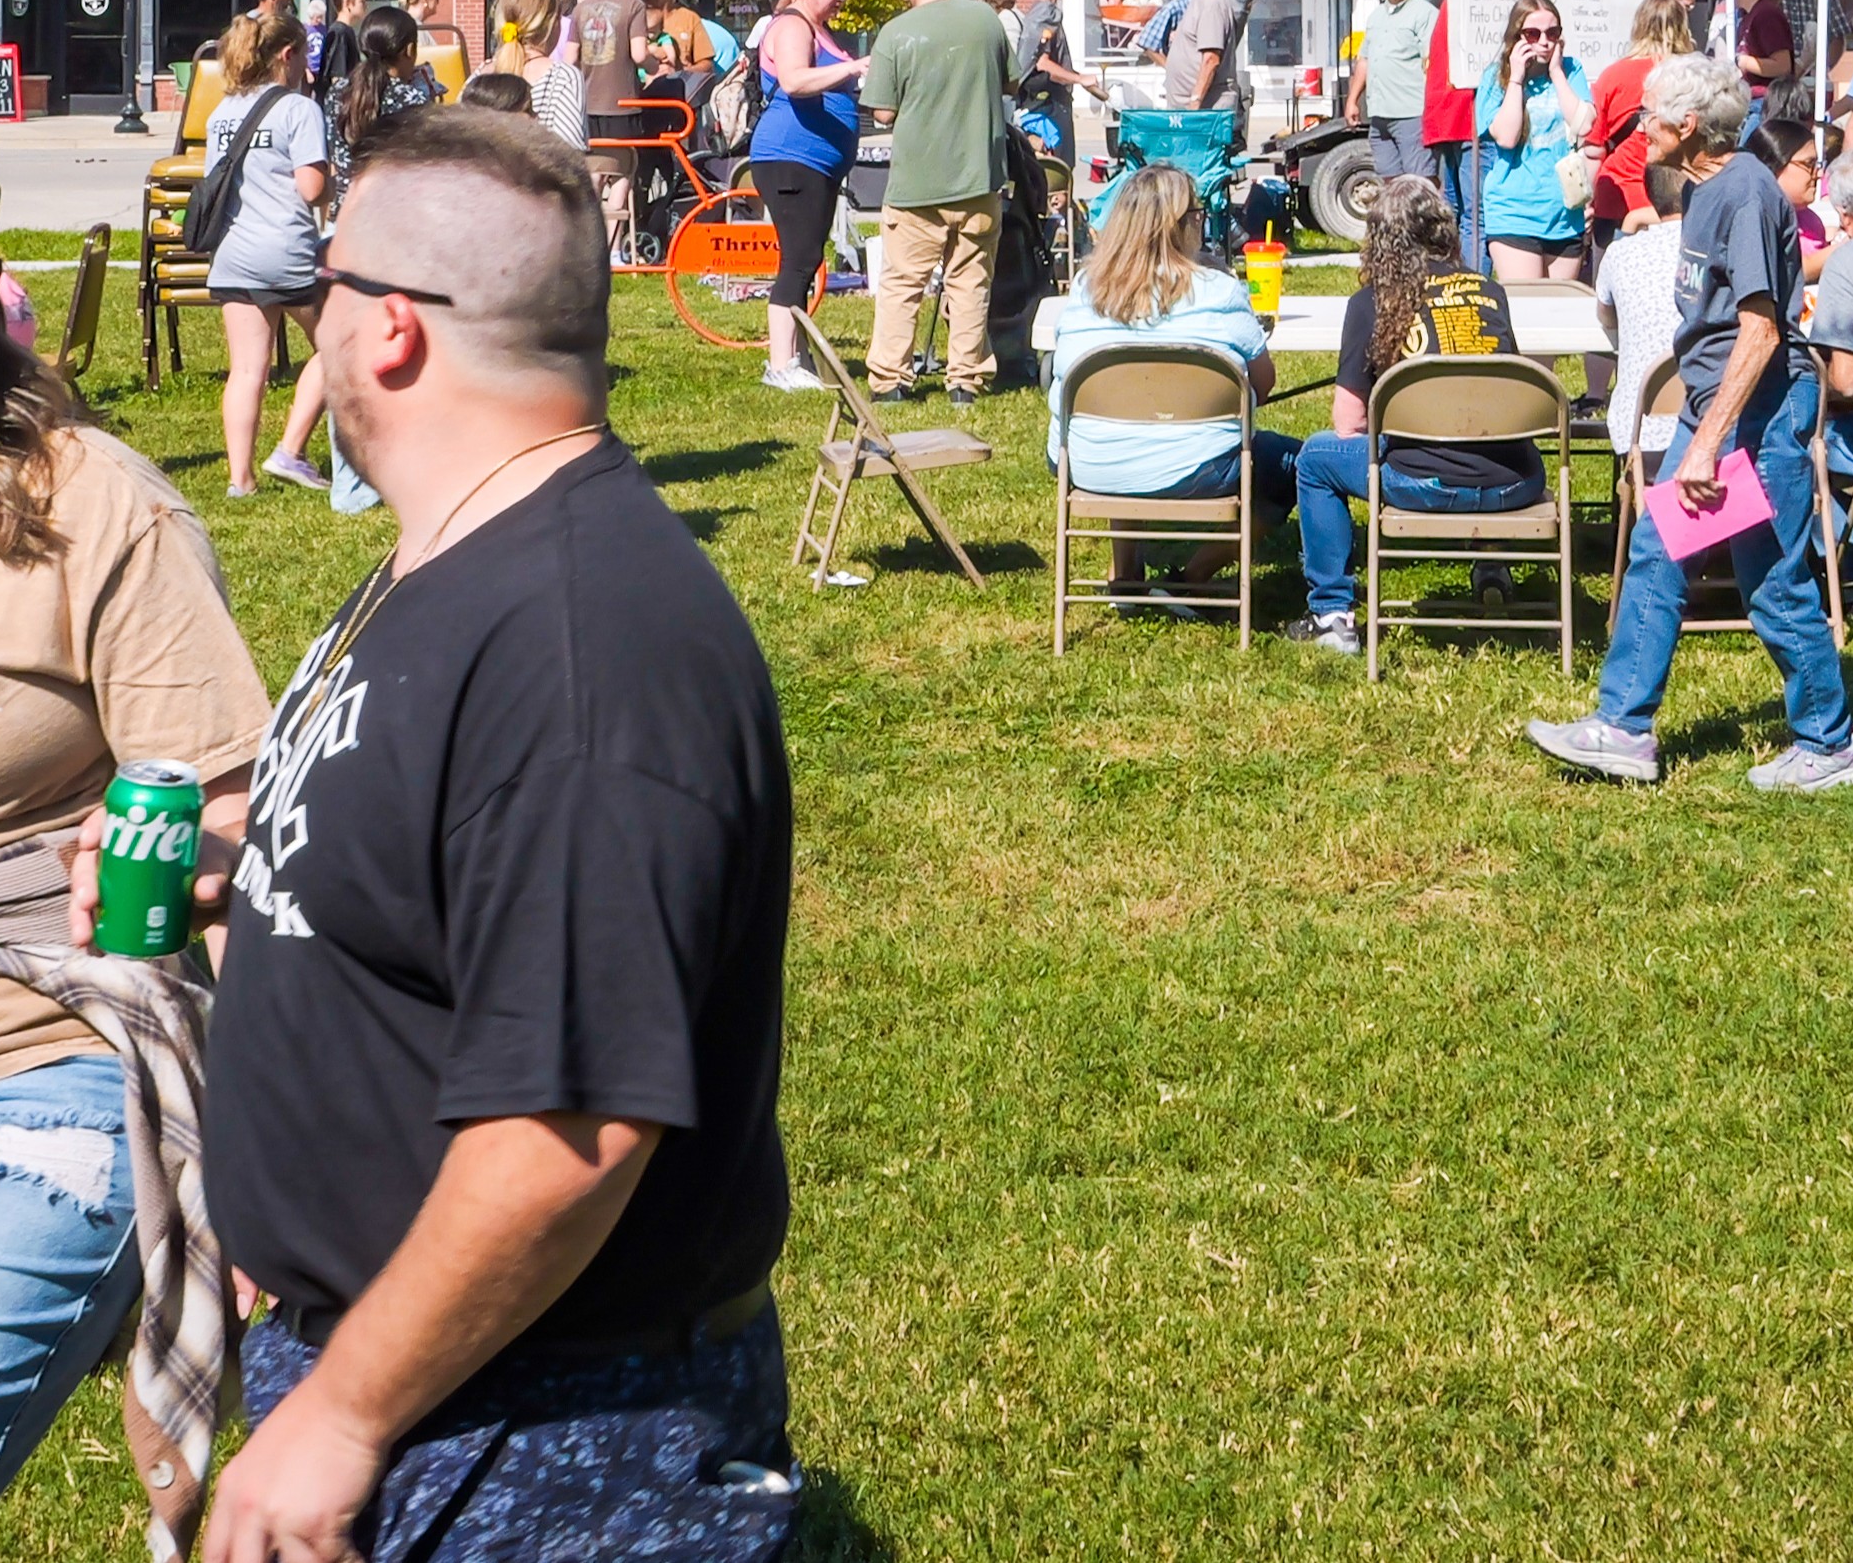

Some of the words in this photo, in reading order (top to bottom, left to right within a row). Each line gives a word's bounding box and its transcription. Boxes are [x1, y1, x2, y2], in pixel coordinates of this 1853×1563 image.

[1469, 5, 1490, 24] Frito
[212, 118, 237, 135] ERE
[99, 803, 194, 863] rite
